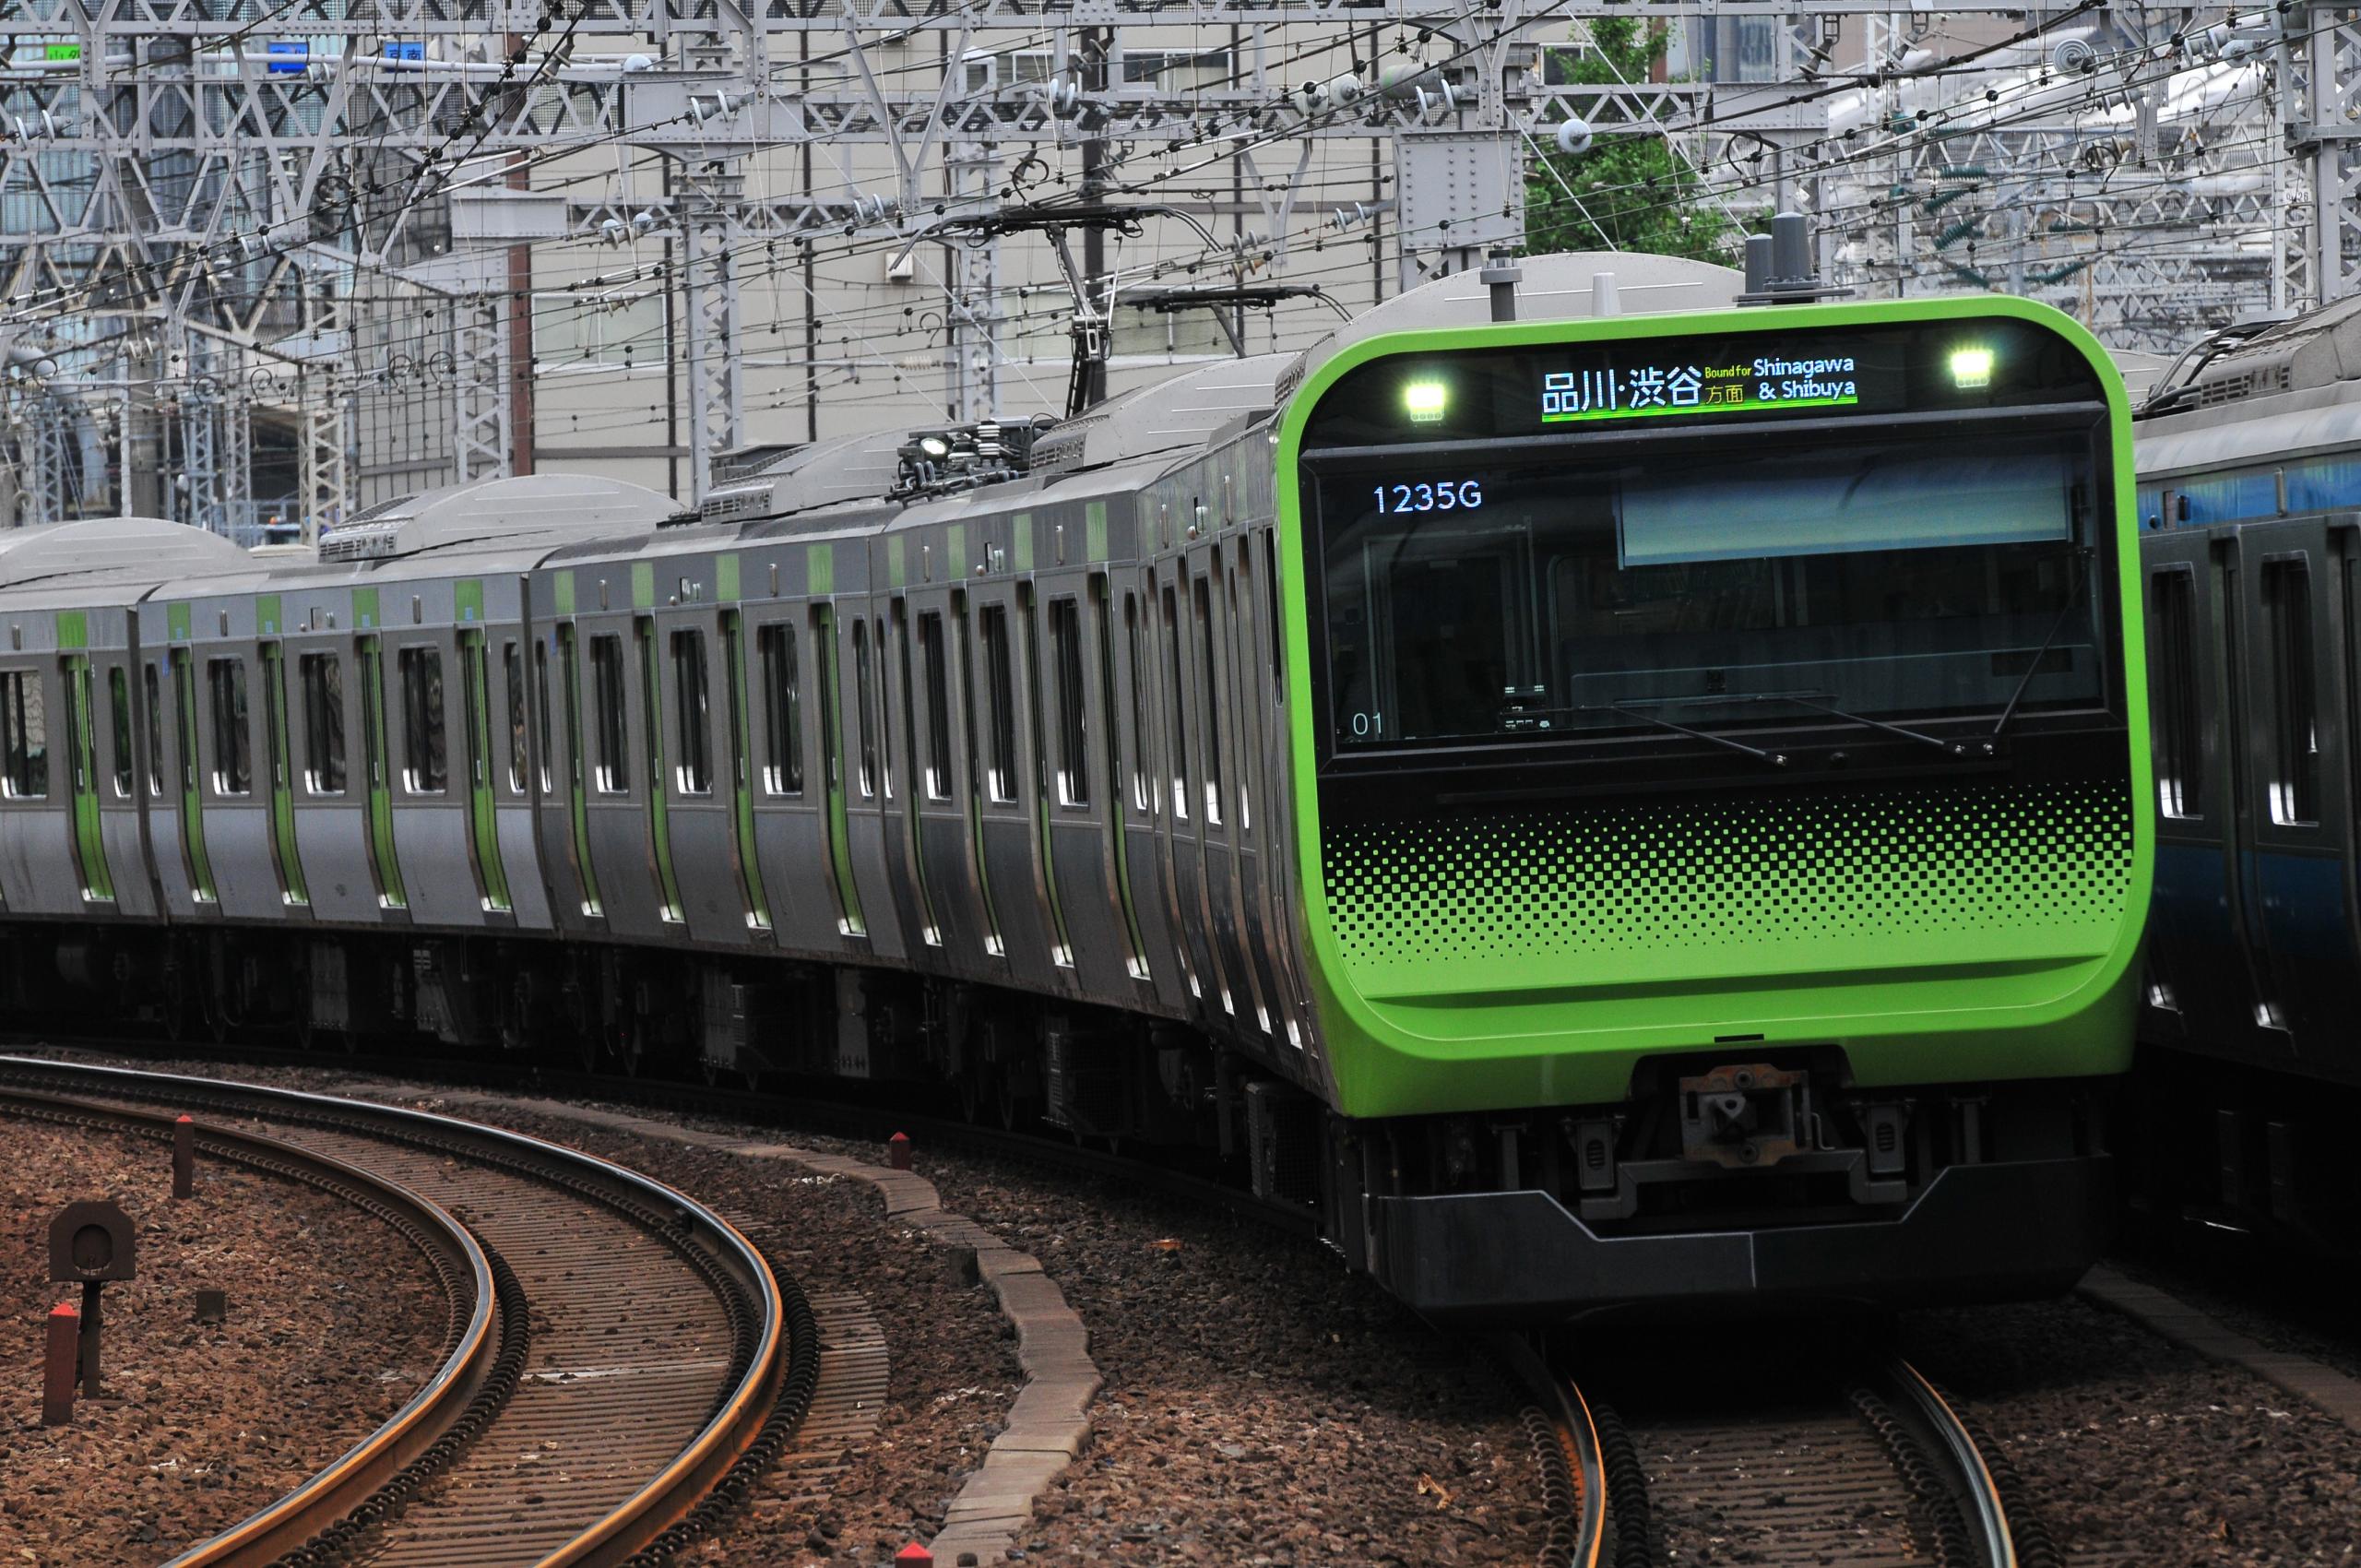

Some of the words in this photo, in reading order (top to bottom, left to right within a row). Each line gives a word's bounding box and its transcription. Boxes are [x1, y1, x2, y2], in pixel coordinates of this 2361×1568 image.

[1704, 365, 1735, 379] Bound
[1736, 364, 1751, 376] for
[1753, 357, 1855, 379] Shinagawa
[1542, 366, 1703, 413] 品川・渋谷
[1704, 384, 1744, 404] 方面
[1759, 382, 1776, 400] &
[1782, 379, 1856, 400] Shibuya
[1373, 481, 1482, 514] 1235G
[1352, 711, 1382, 736] 01
